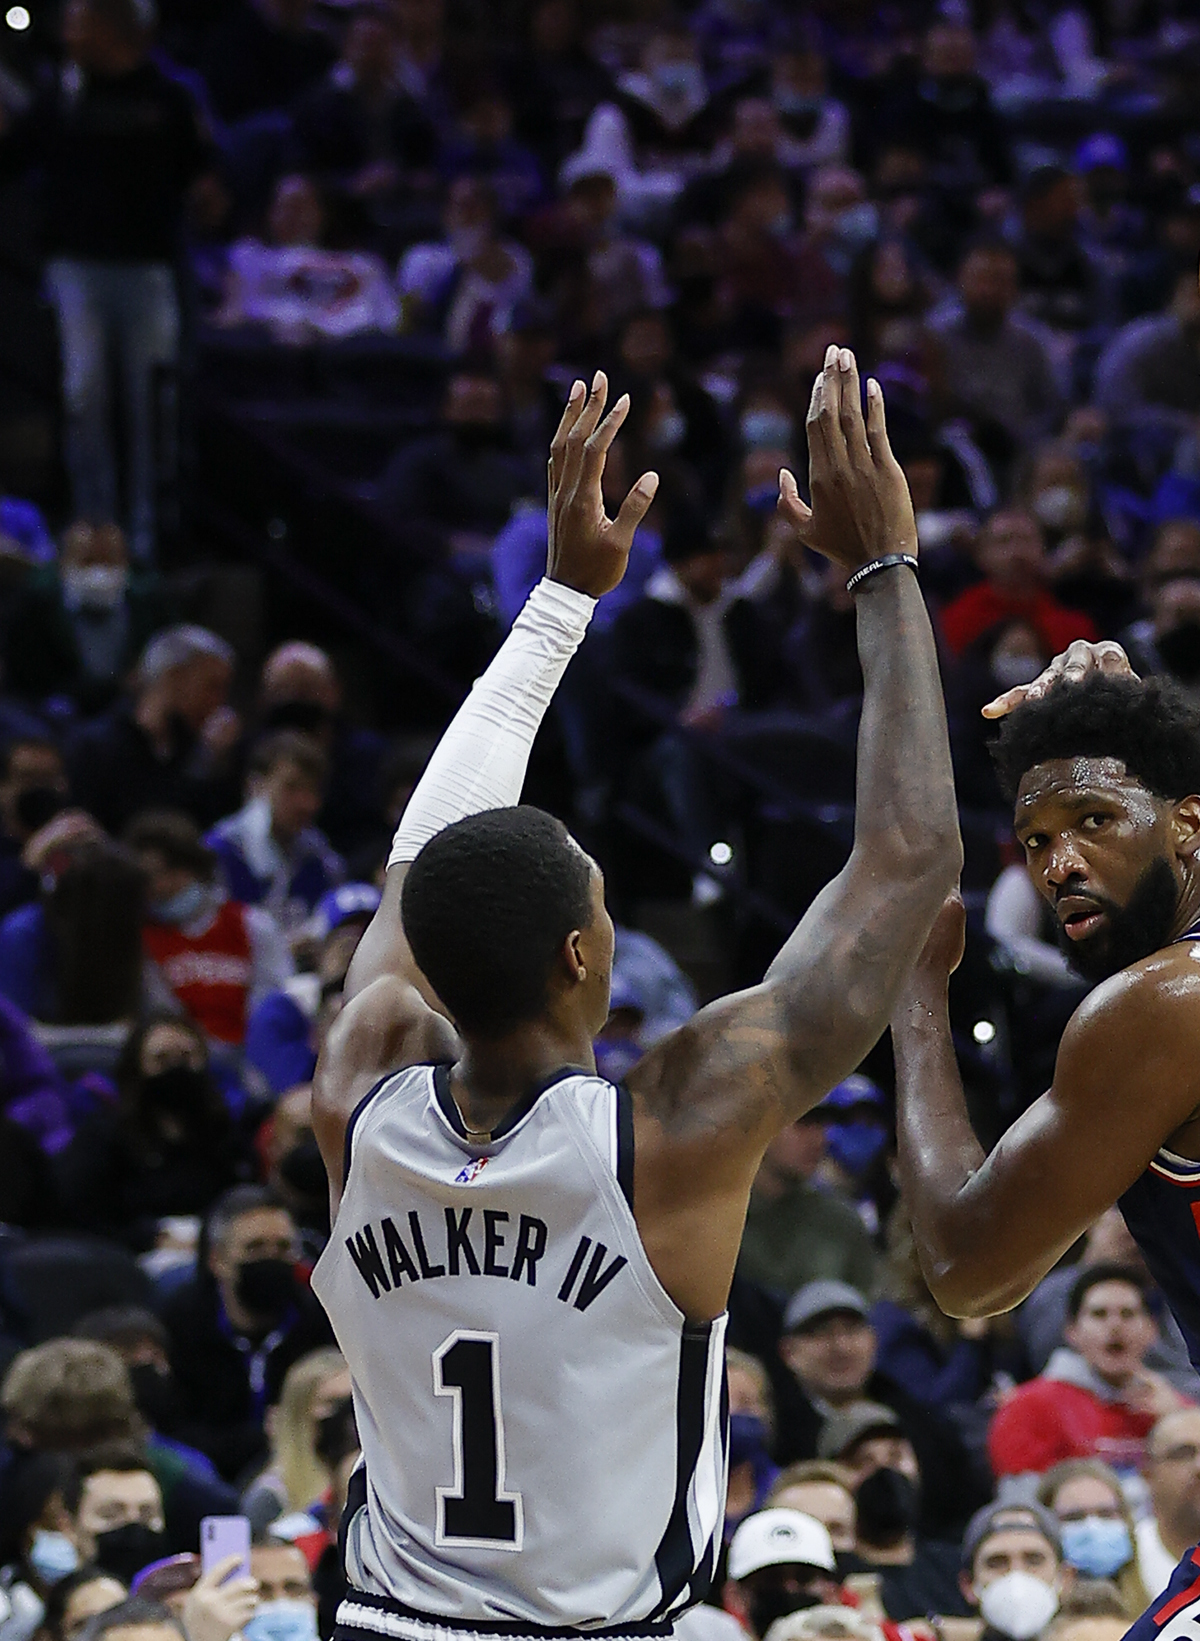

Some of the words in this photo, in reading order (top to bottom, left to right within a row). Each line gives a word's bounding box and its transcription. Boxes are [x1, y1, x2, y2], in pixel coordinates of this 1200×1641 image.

[345, 1207, 548, 1300] WALKER
[557, 1236, 628, 1313] IV
[432, 1329, 525, 1552] 1
